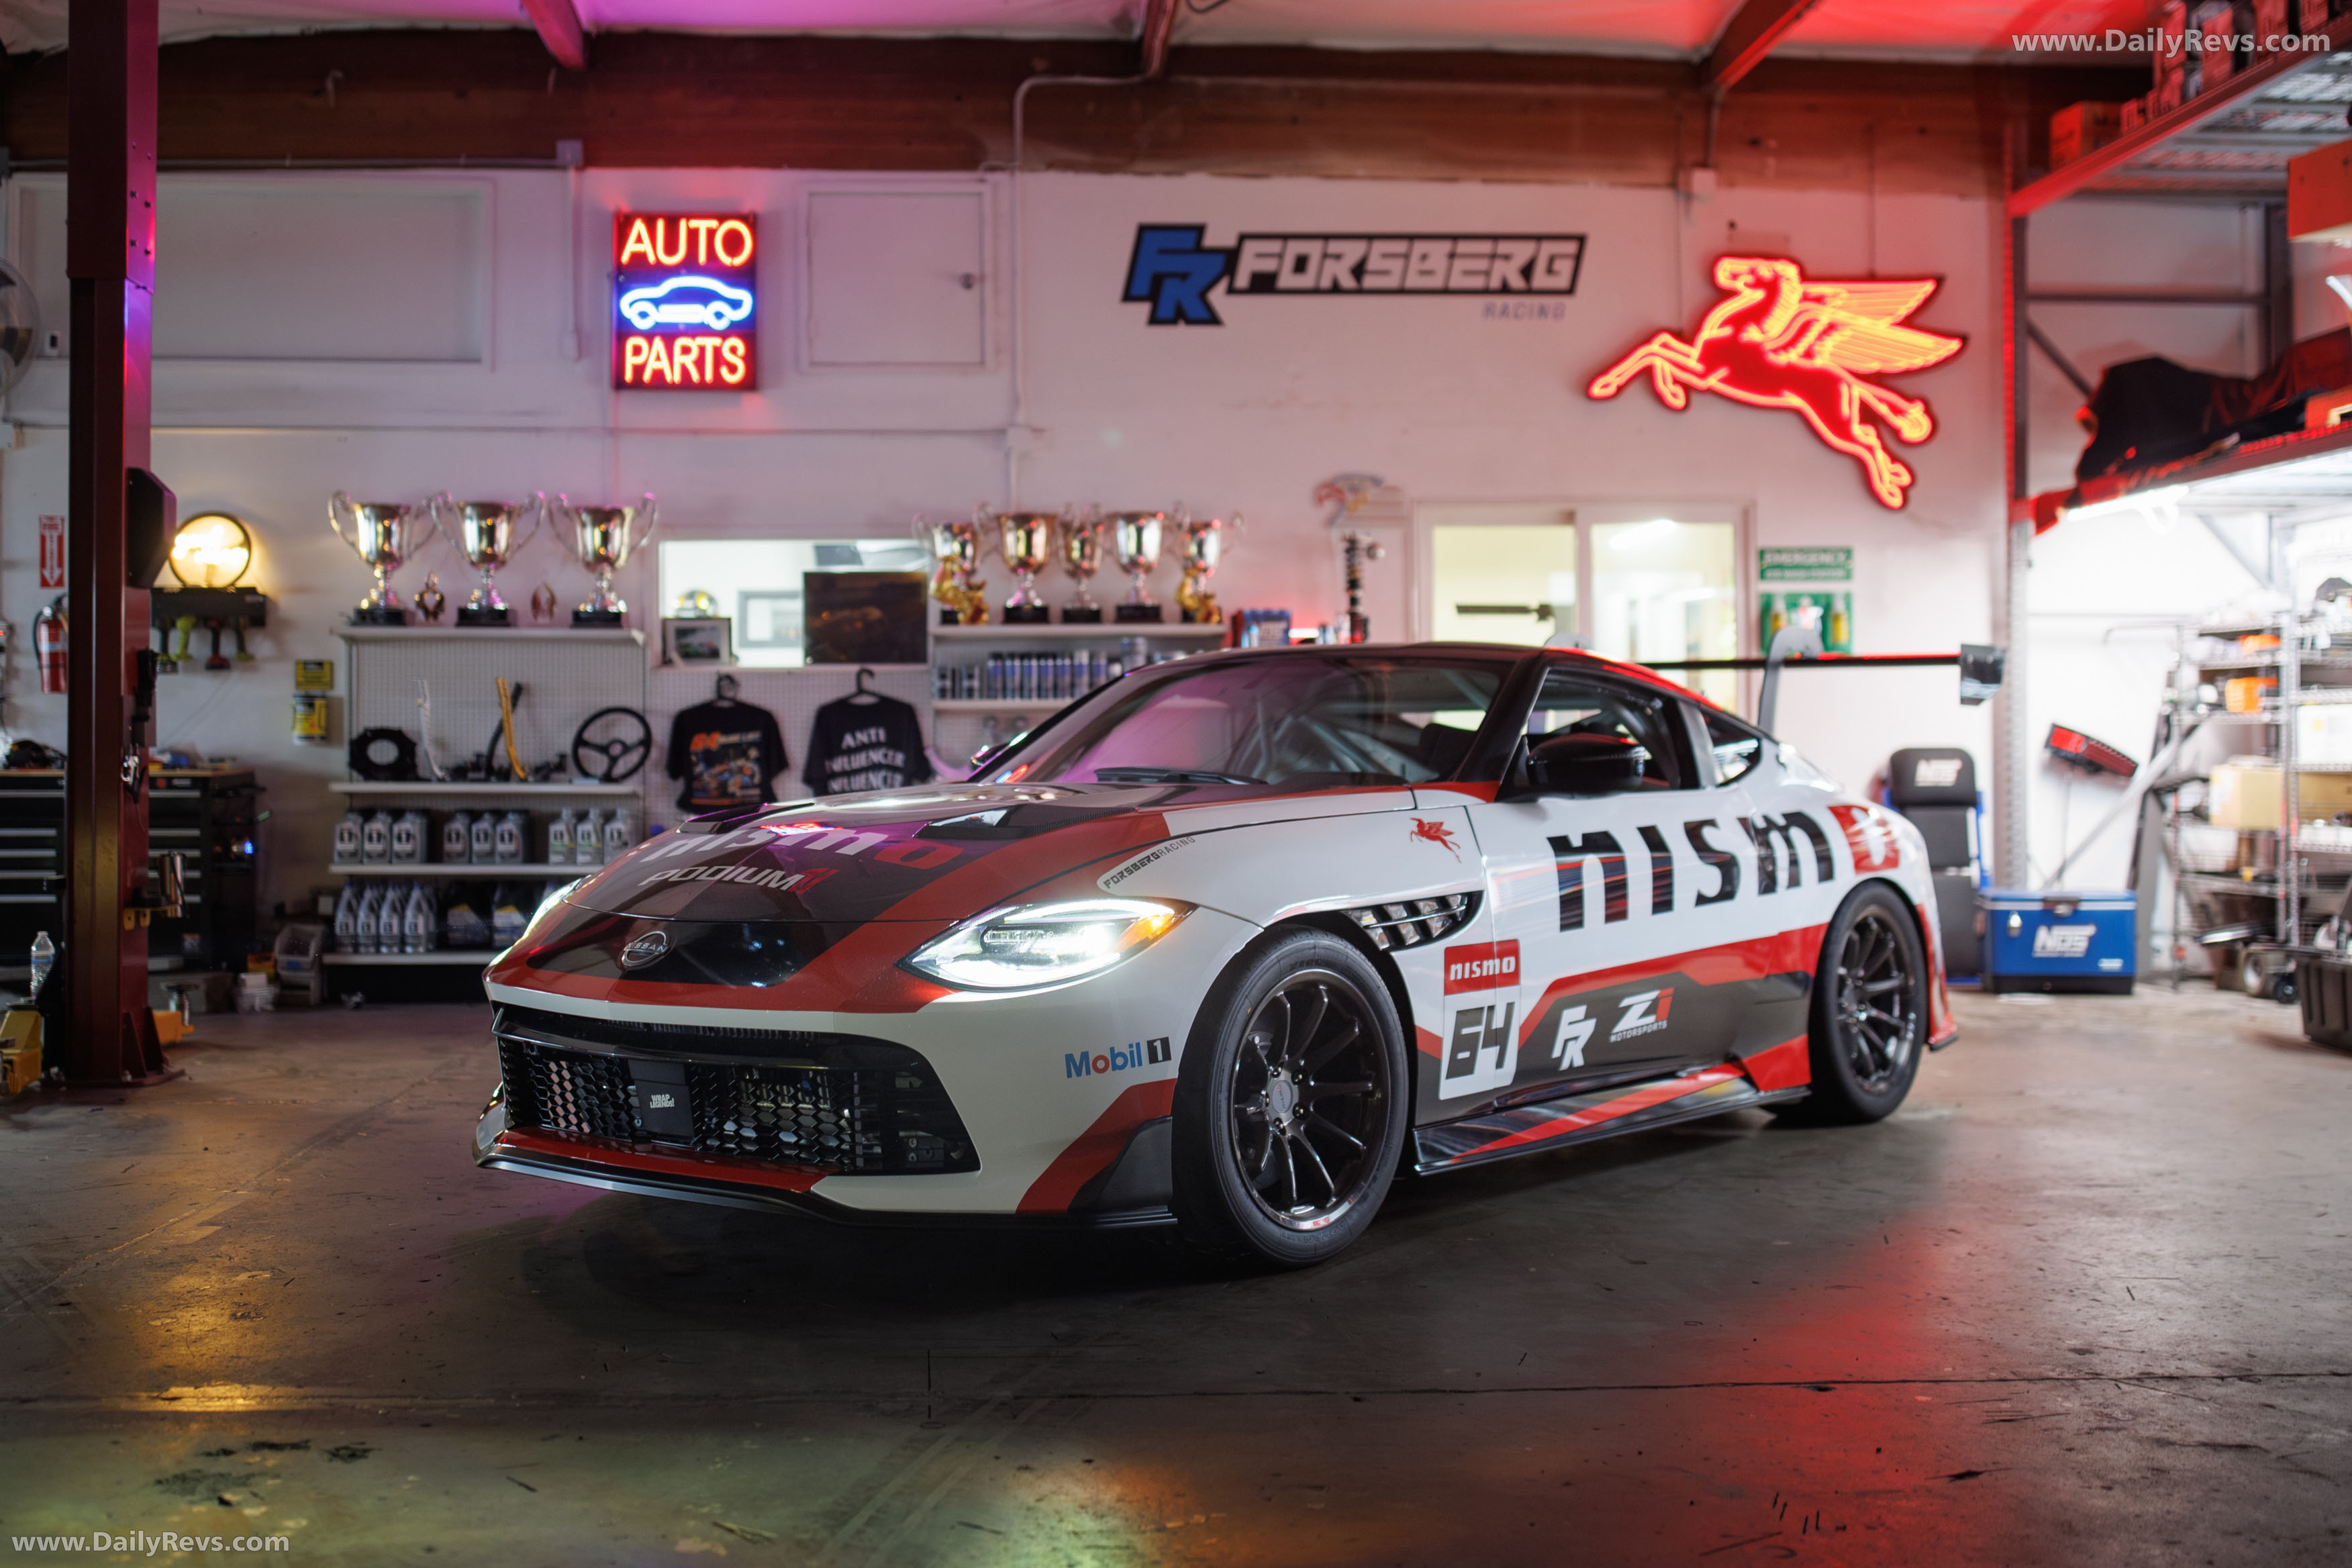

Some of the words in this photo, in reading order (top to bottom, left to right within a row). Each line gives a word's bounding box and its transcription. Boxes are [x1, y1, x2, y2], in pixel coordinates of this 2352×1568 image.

[621, 217, 752, 266] AUTO
[1230, 235, 1584, 293] FORSBERG
[1482, 301, 1566, 320] RACING
[625, 335, 746, 384] PARTS
[841, 727, 886, 750] ANTI
[827, 769, 904, 793] NFLUENCER
[628, 942, 668, 952] NISSAN
[1449, 956, 1516, 981] nismo
[1445, 1001, 1516, 1080] 64
[1608, 1020, 1667, 1042] MOTORSPORTS
[1065, 1042, 1143, 1079] Mobil
[651, 1093, 671, 1102] WRAP
